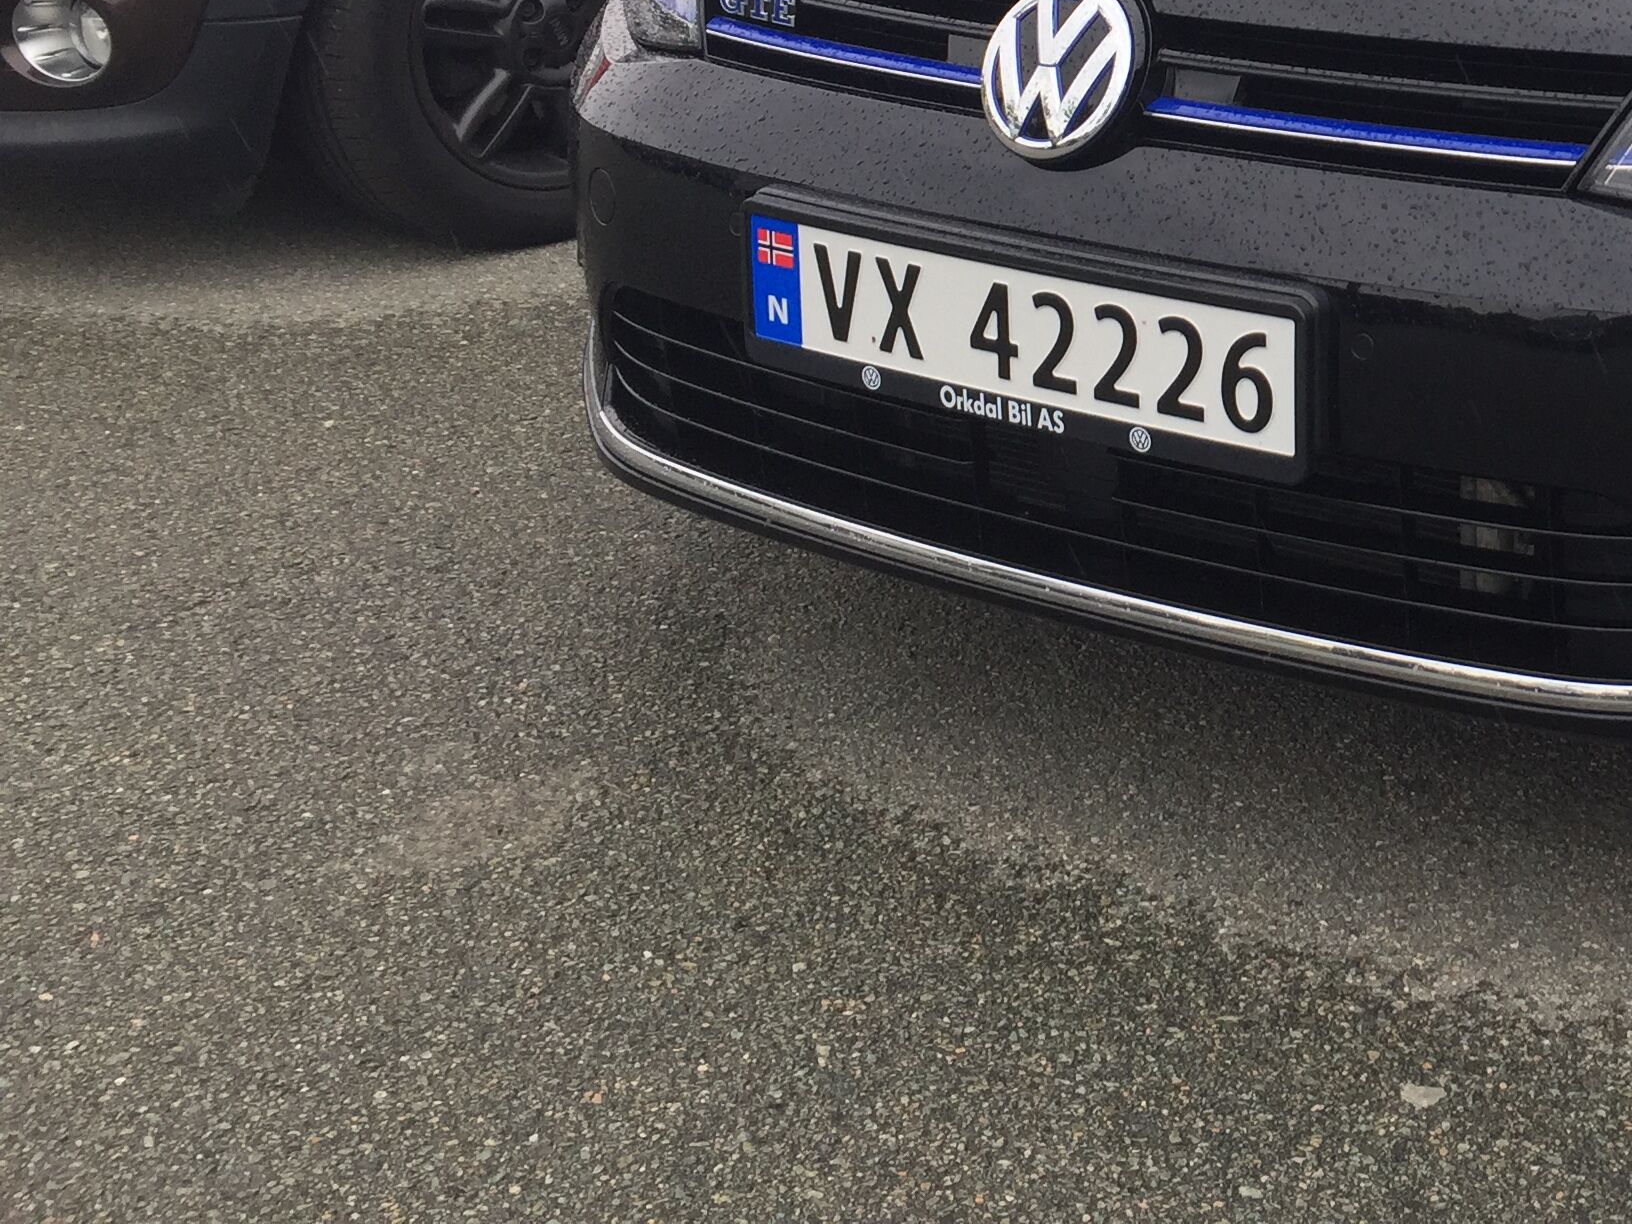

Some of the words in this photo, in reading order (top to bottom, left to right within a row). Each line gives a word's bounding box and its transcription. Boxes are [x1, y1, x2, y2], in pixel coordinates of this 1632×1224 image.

[767, 294, 789, 325] N
[813, 242, 925, 361] VX
[970, 281, 1274, 434] 42226
[939, 384, 1003, 421] Orkdal
[1008, 399, 1033, 427] Bil
[1037, 407, 1066, 435] AS
